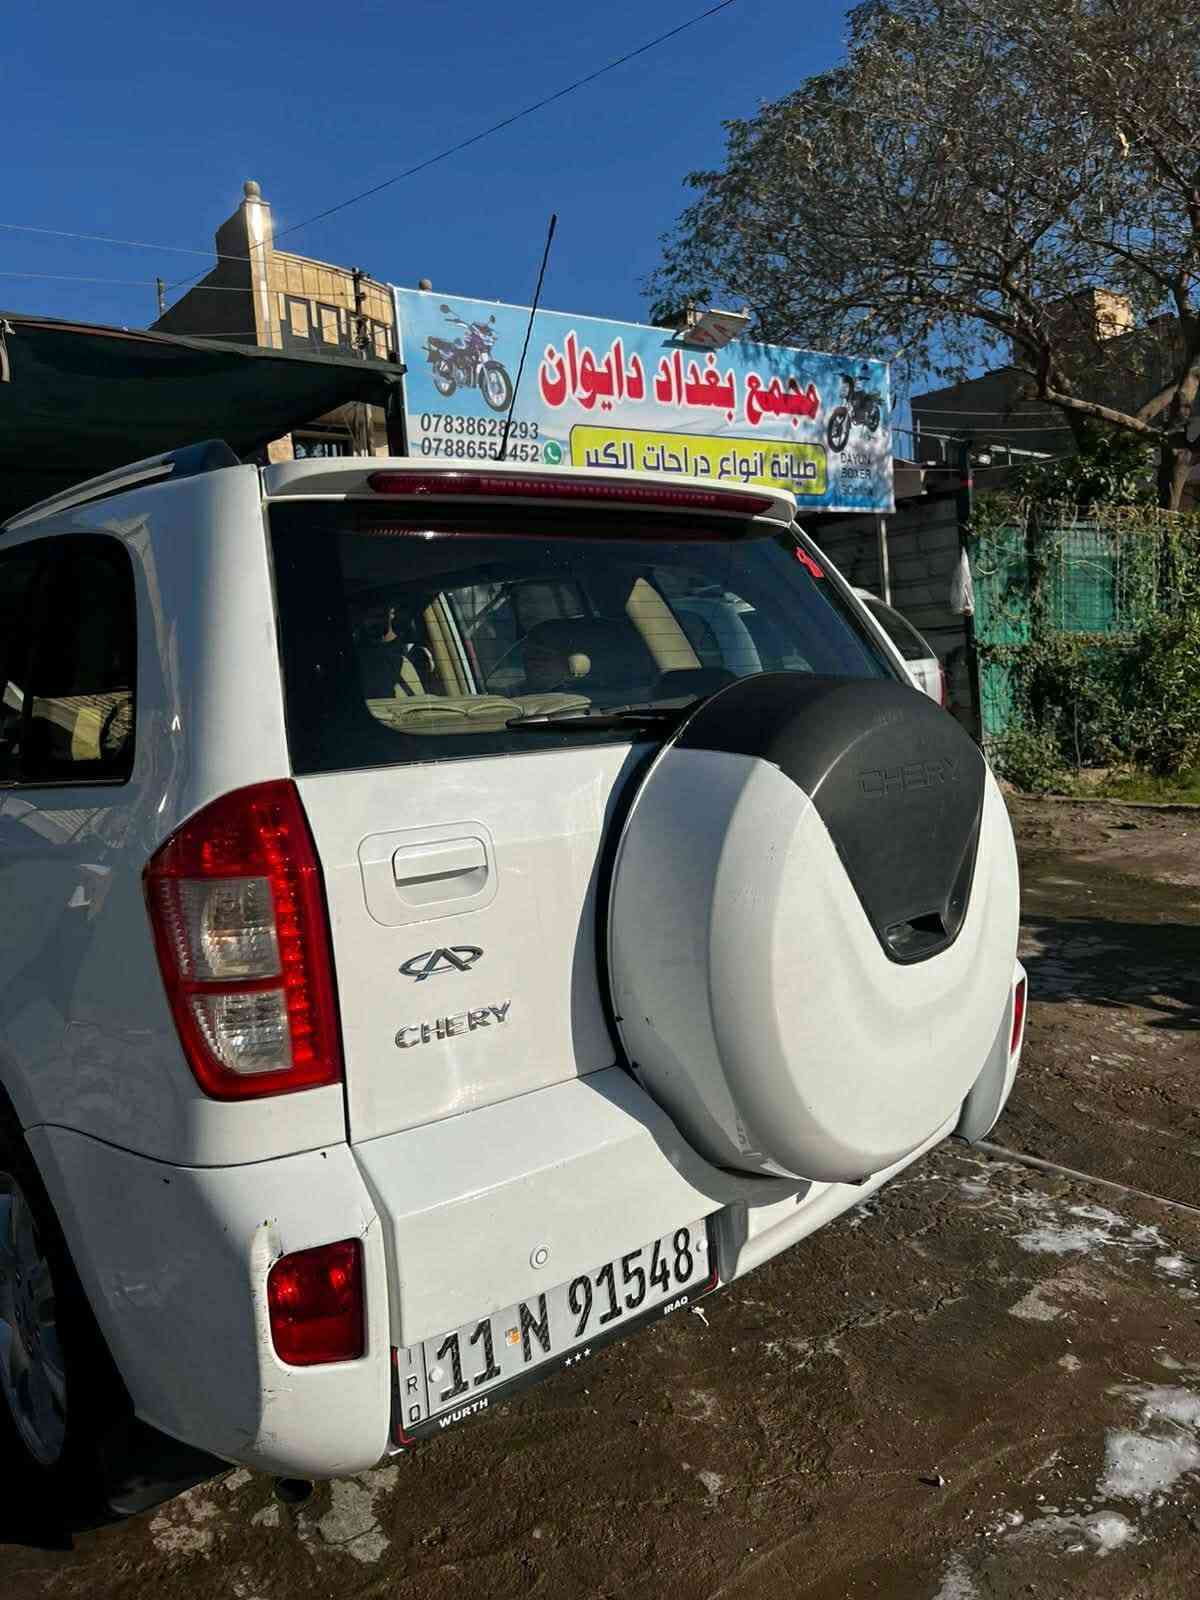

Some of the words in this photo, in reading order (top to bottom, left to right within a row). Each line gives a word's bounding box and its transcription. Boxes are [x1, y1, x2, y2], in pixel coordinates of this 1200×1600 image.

[539, 329, 645, 411] دايوان
[656, 350, 736, 426] بغداد
[746, 373, 821, 427] مجمع
[421, 437, 539, 462] 0788655452
[718, 450, 764, 483] انواع
[771, 453, 817, 487] صيانة
[857, 757, 960, 798] CHERY
[394, 999, 511, 1049] CHERY
[436, 1318, 501, 1402] 11
[519, 1292, 551, 1362] N
[568, 1227, 693, 1338] 91548
[439, 1398, 489, 1428] WURTH
